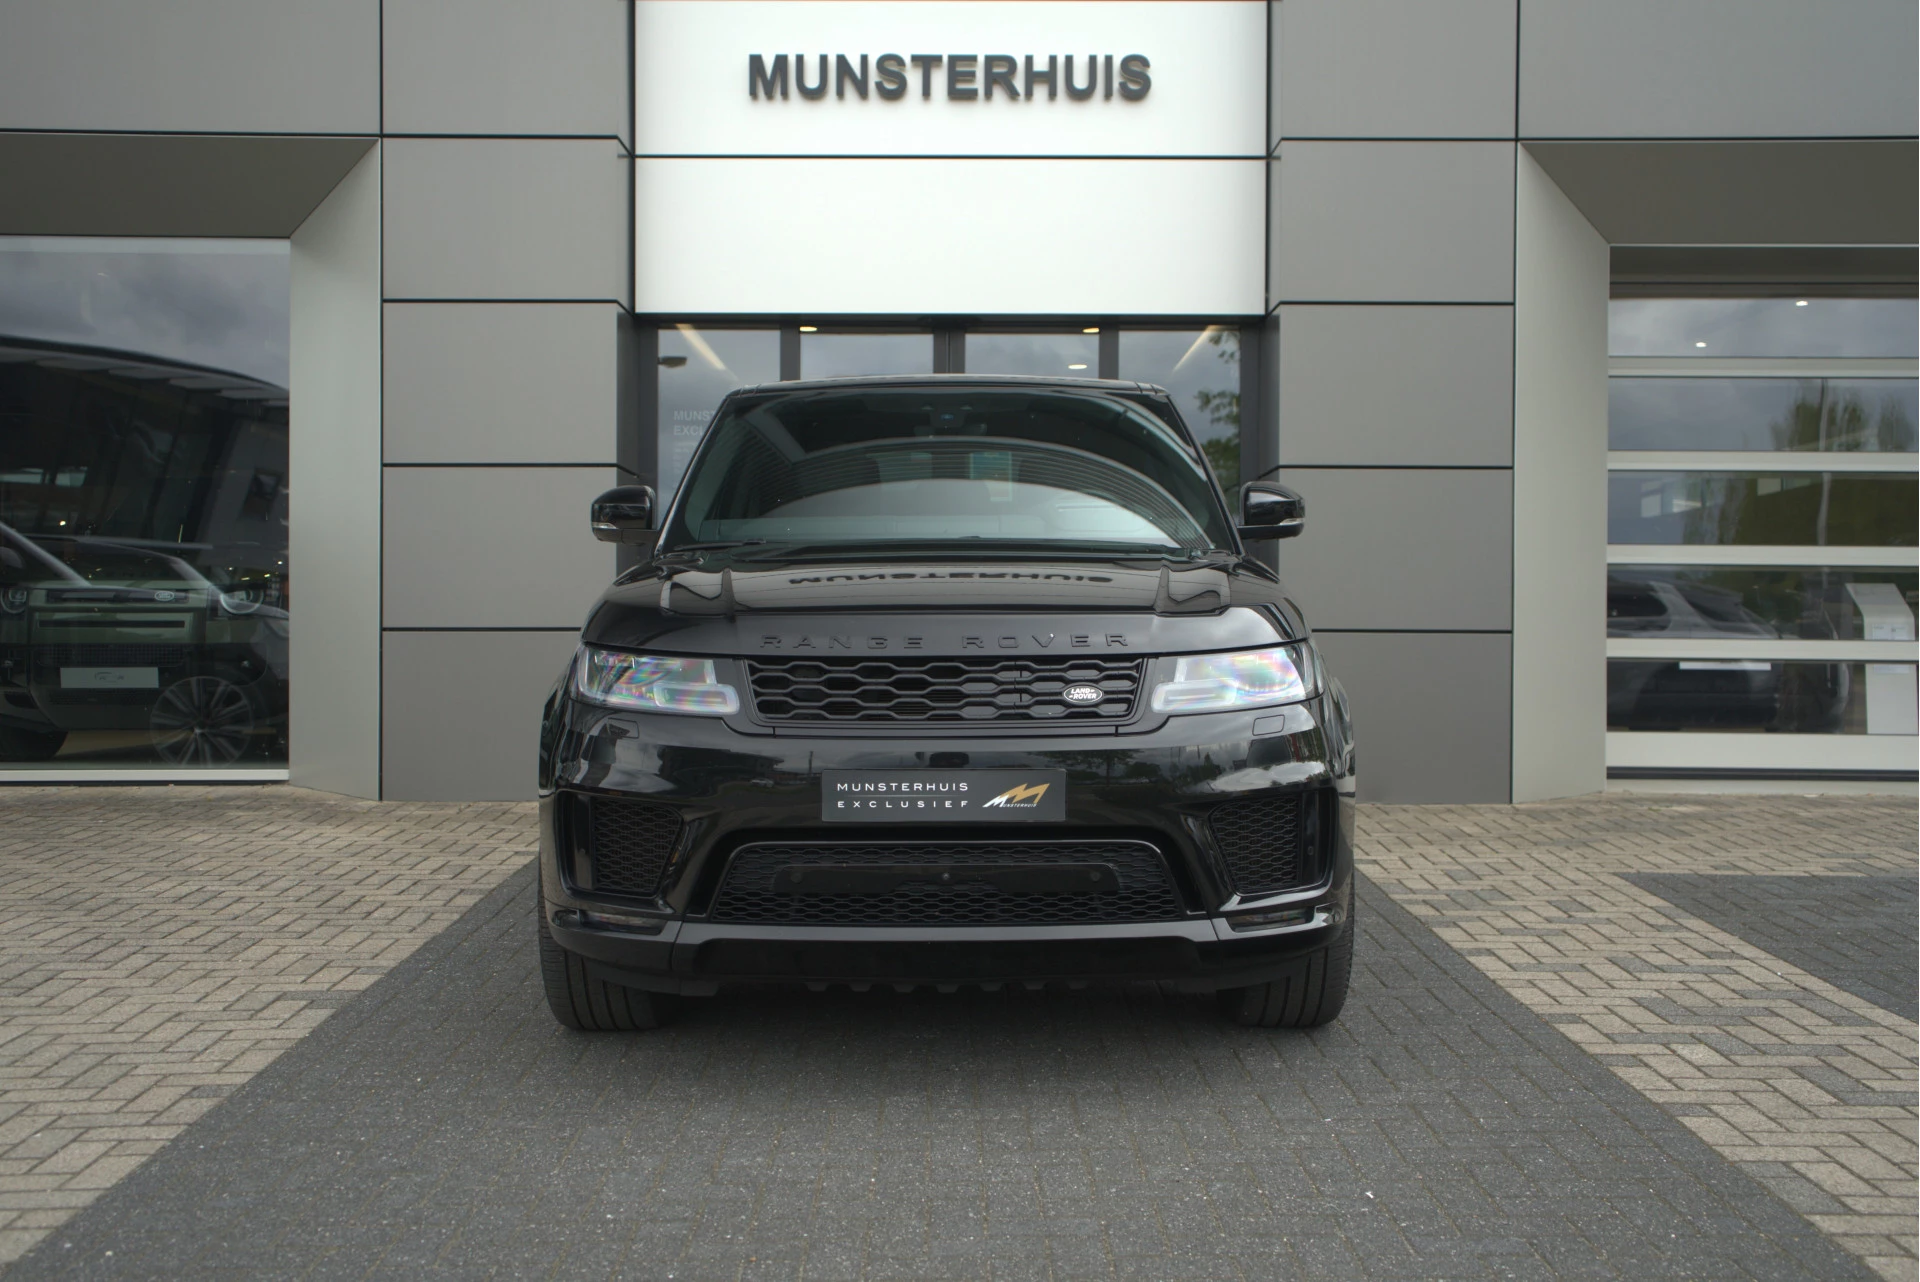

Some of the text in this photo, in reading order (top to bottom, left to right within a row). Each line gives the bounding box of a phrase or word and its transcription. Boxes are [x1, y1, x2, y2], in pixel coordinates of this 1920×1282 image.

[749, 53, 1152, 100] MUNSTERHUIS
[760, 633, 1129, 649] RANGE ROVER
[837, 782, 969, 792] MUNSTERHUIS
[837, 800, 969, 809] EXCLUSIEF
